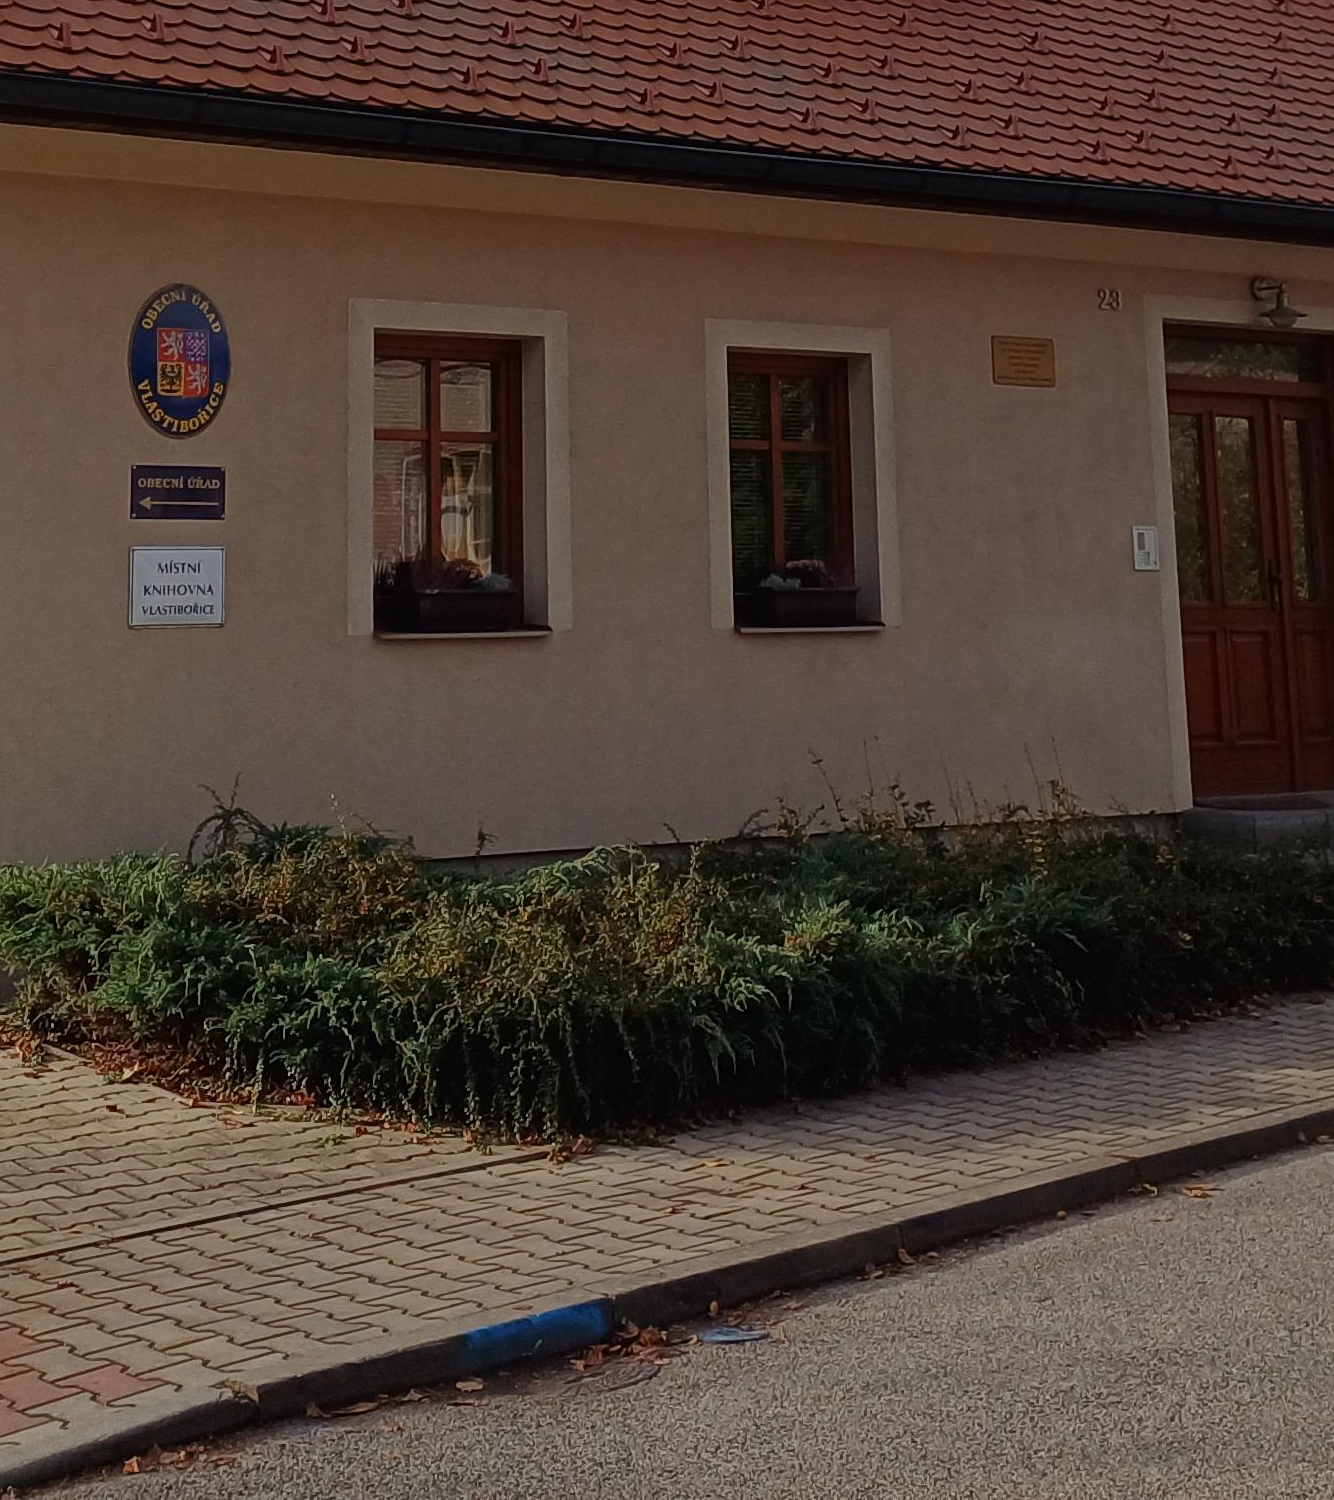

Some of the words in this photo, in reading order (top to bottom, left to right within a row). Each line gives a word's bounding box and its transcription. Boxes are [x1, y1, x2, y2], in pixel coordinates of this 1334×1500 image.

[137, 379, 224, 433] VLASTIBOŘICE
[138, 476, 184, 489] OBECNÍ
[187, 476, 221, 489] ÚŘAD
[157, 560, 201, 574] MÍSTNÍ
[143, 584, 214, 596] KNIHOVNA
[141, 602, 215, 616] VLASTIBOŘICE
